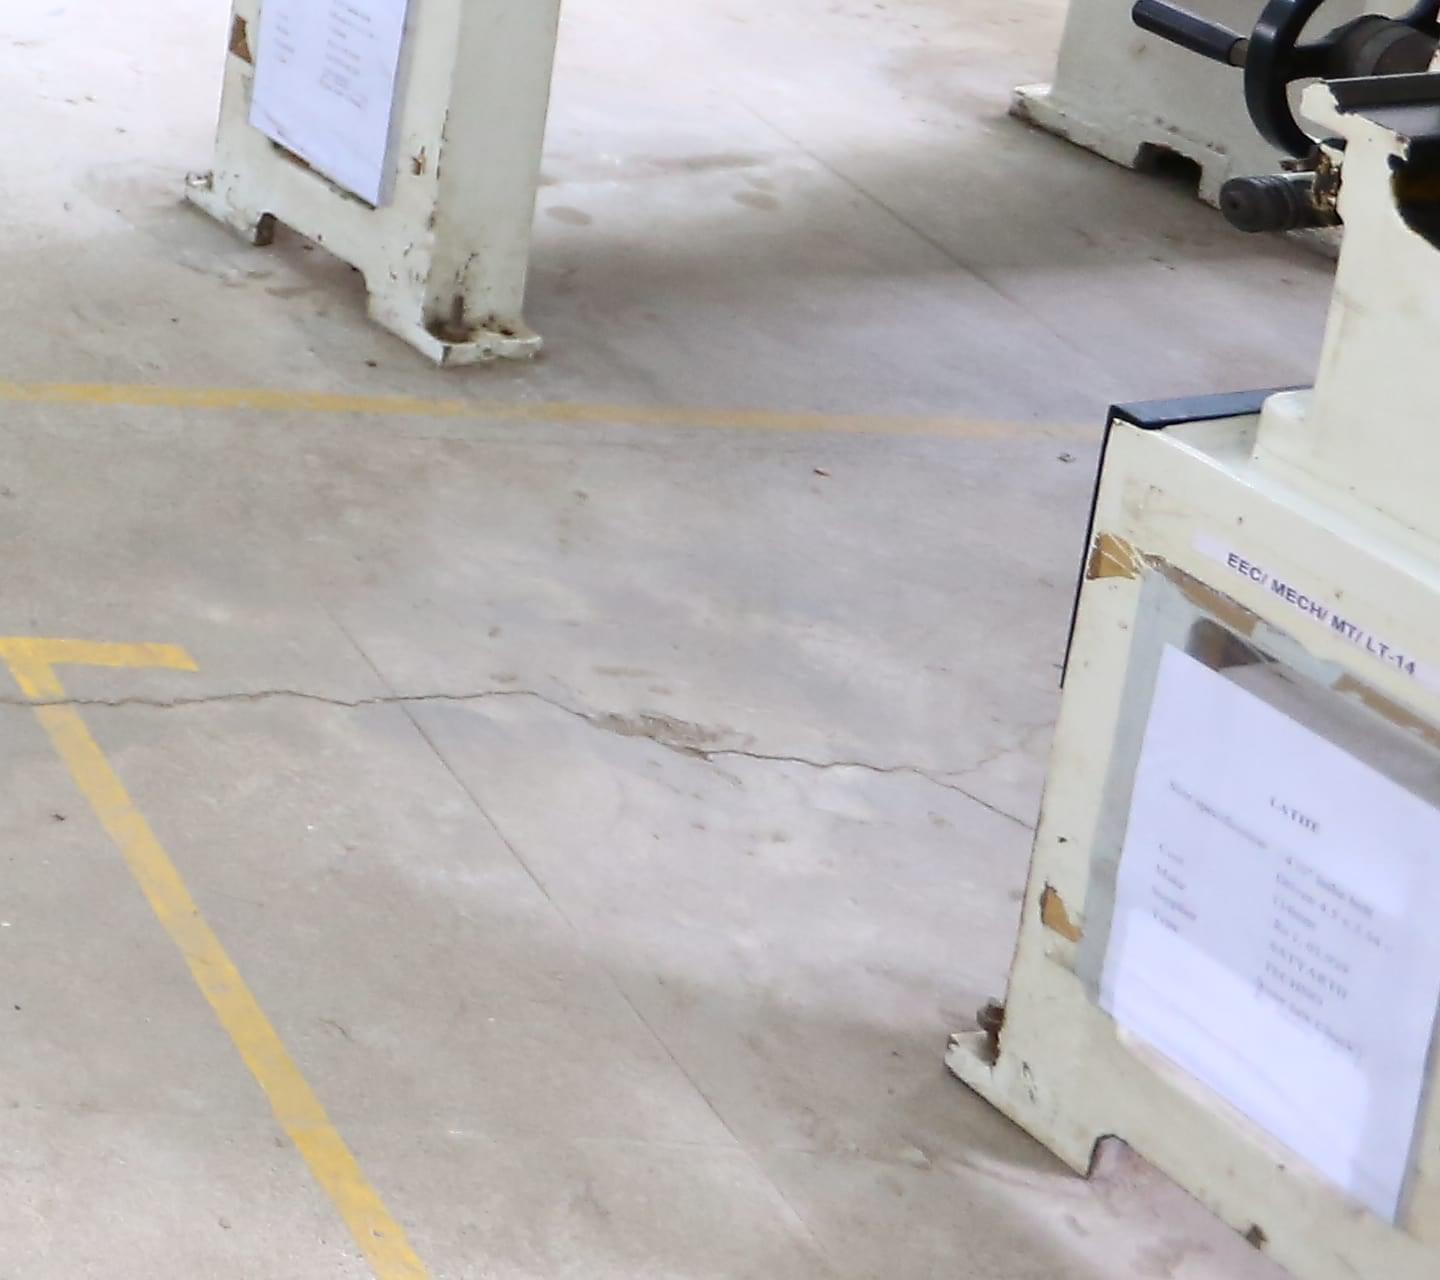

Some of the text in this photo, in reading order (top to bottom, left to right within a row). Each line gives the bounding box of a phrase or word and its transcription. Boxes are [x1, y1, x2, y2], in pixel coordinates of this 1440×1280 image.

[1227, 552, 1415, 675] EEC/ MECH/ MT/ LT-14
